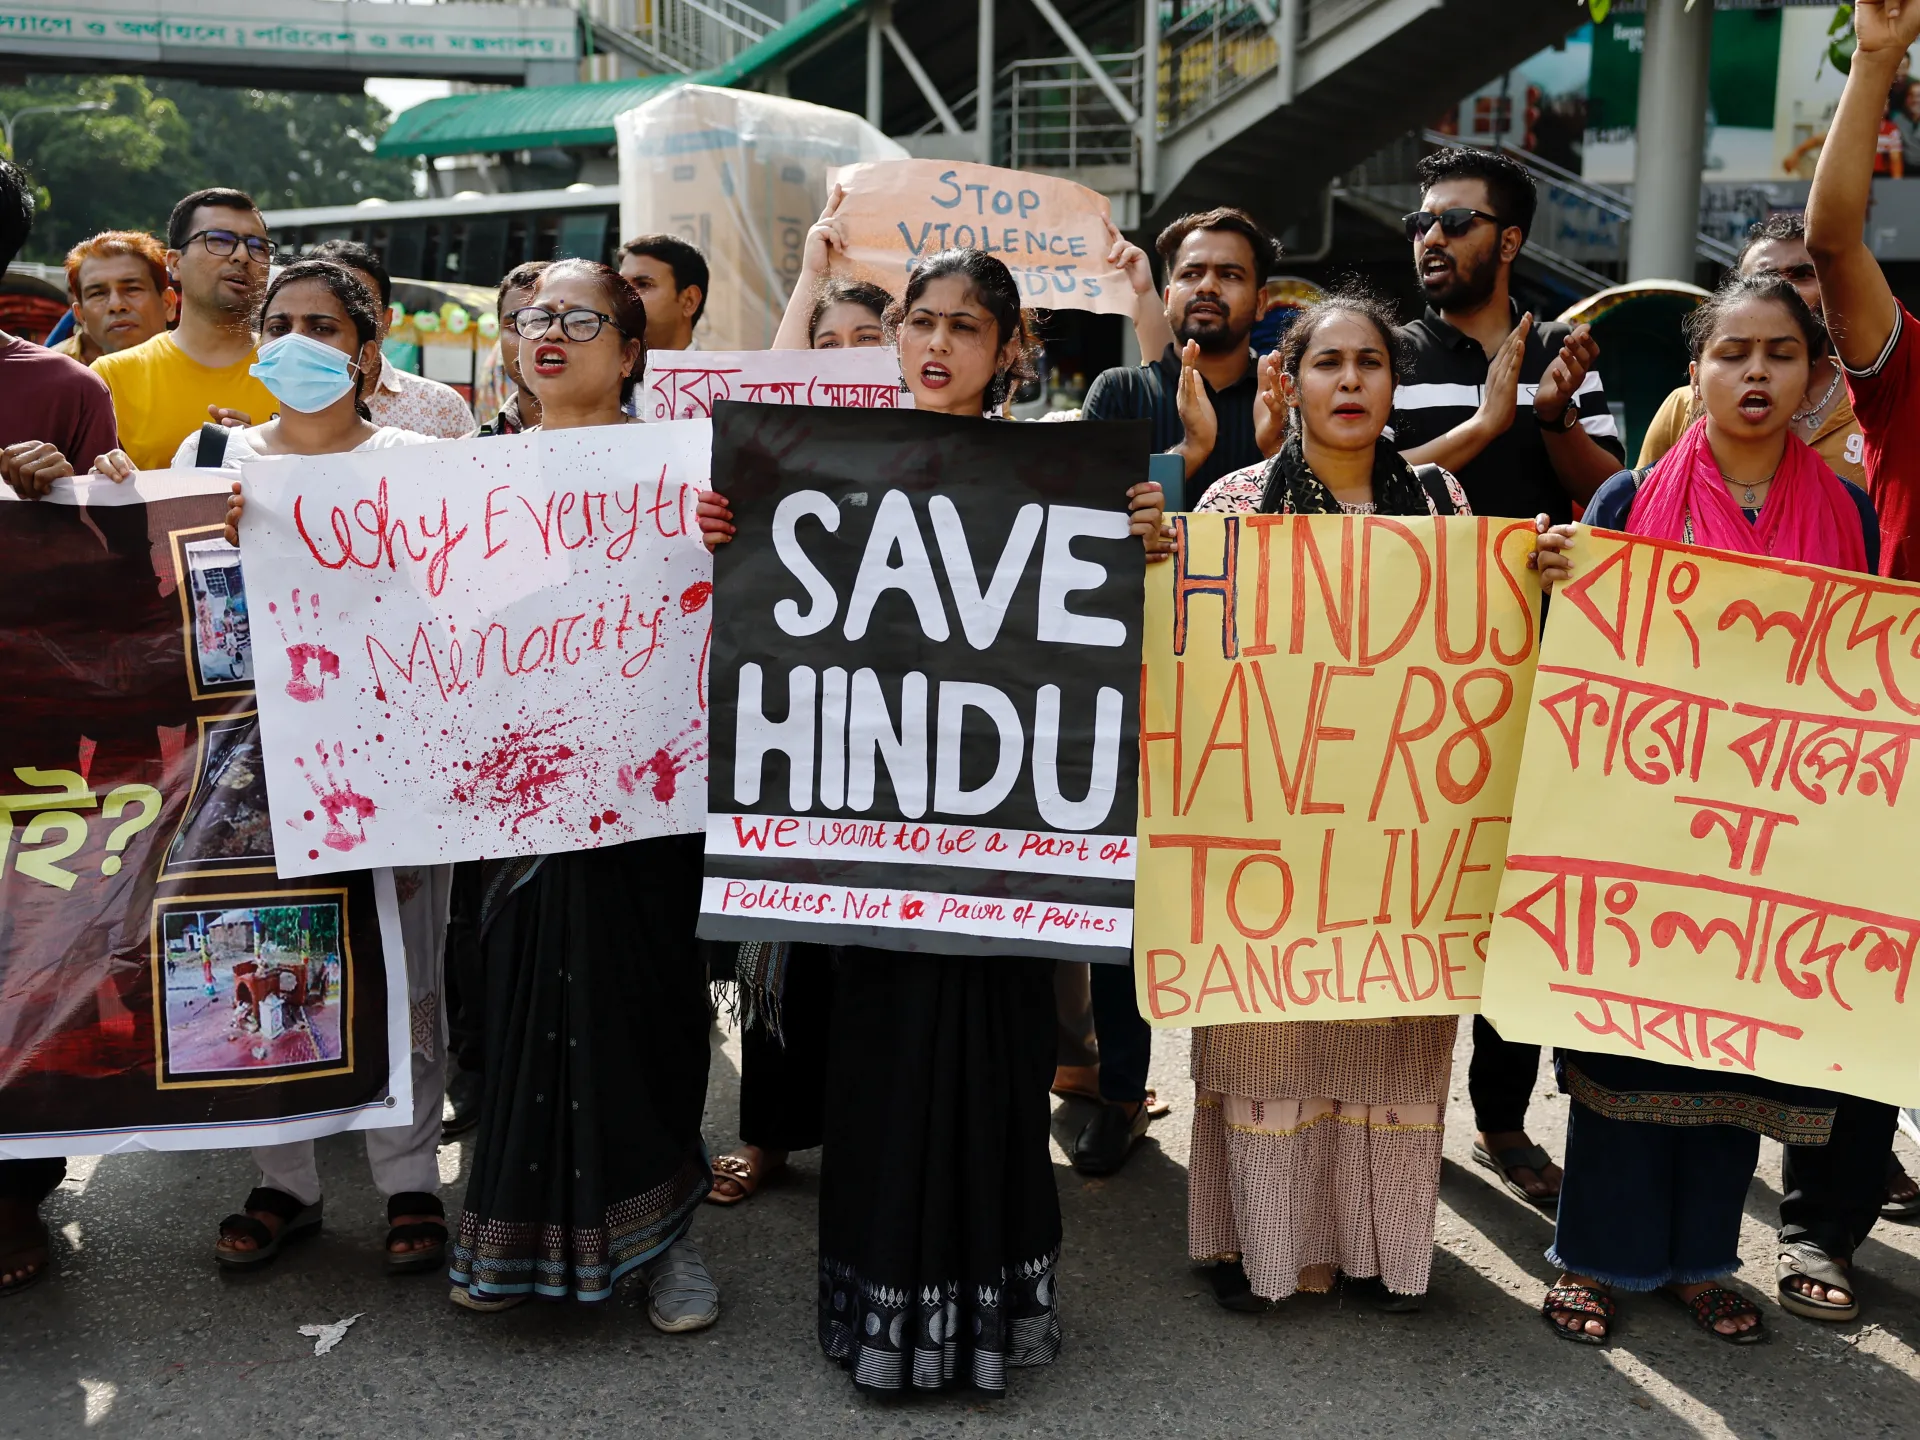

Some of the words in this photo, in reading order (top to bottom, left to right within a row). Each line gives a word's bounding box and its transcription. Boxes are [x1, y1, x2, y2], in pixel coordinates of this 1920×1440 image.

[897, 221, 1088, 257] VIOLENCE
[930, 170, 1040, 219] STOP
[294, 476, 468, 598] Why
[771, 488, 1132, 651] SAVE
[1171, 515, 1538, 667] HINDUS
[366, 593, 665, 703] Minority
[733, 661, 1124, 831] HINDU
[984, 832, 1009, 852] a
[1099, 837, 1131, 864] of
[1148, 833, 1295, 945] TO
[1689, 794, 1800, 877] না
[842, 890, 893, 920] Not
[1012, 902, 1036, 930] of
[1500, 854, 1920, 1012] বাংলাদেশ
